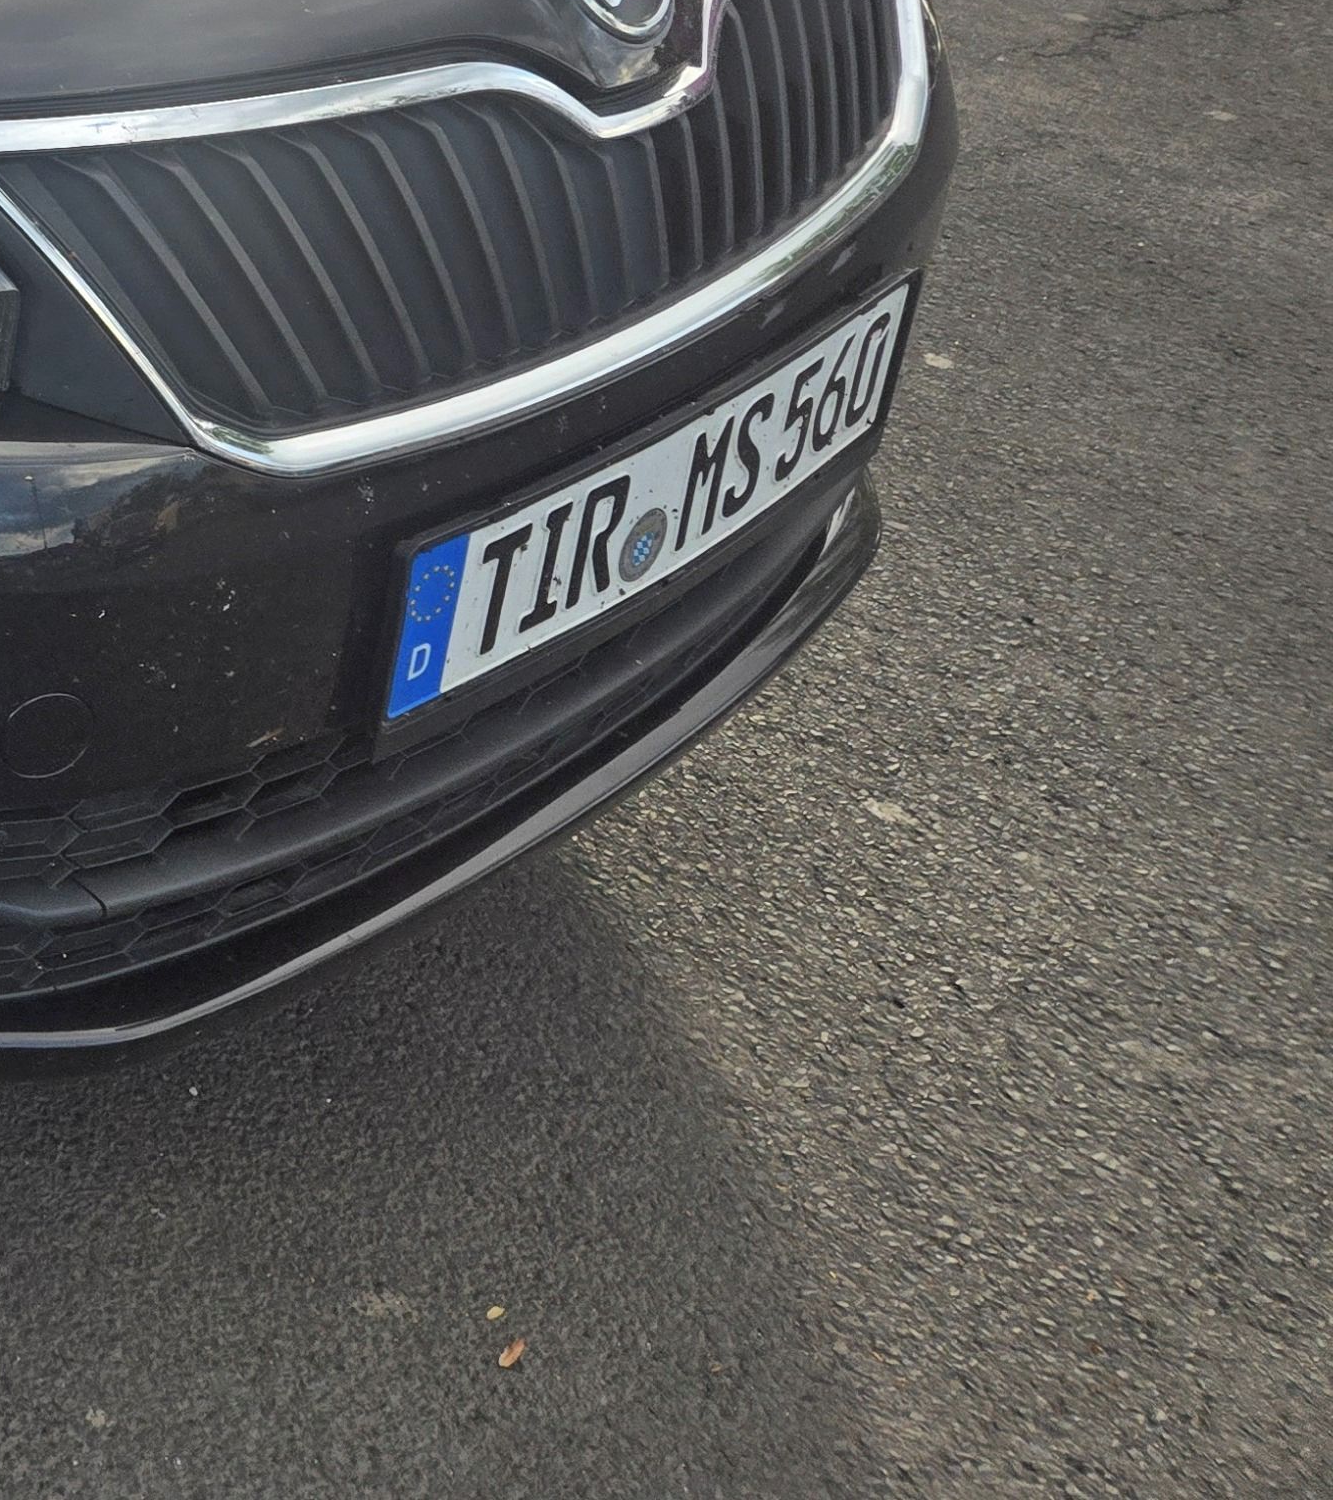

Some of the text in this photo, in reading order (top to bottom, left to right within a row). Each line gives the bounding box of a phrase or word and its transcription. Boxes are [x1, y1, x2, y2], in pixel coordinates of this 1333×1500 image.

[480, 312, 892, 655] TIR MS 560
[406, 642, 432, 682] D
